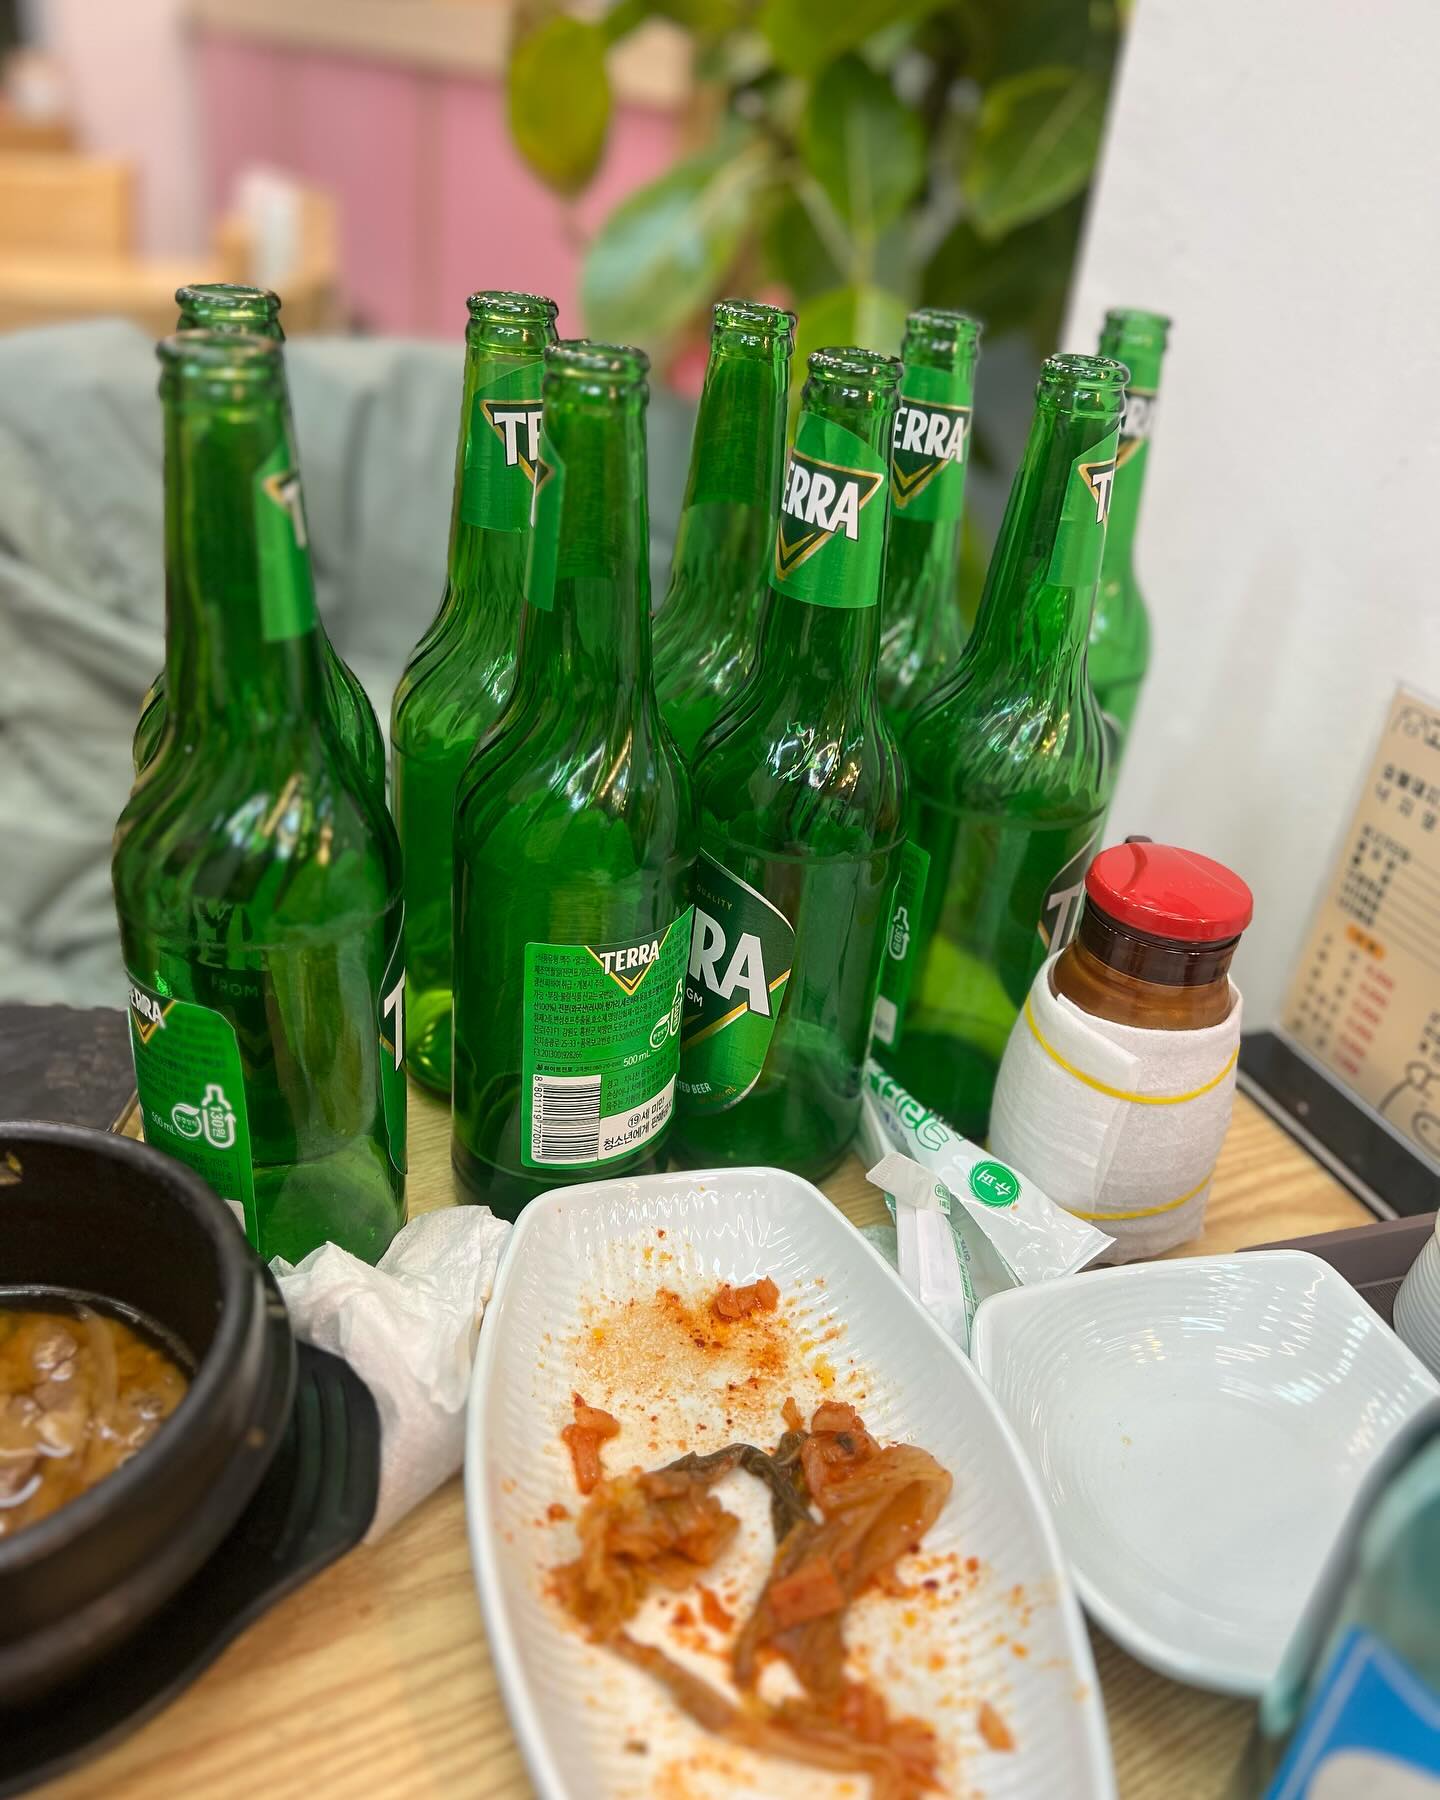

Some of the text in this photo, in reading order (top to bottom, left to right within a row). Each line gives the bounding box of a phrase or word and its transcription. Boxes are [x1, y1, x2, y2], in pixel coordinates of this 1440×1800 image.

[599, 939, 660, 975] TERRA
[623, 1055, 638, 1067] 500
[639, 1050, 651, 1061] mL
[692, 1082, 712, 1094] BEER
[603, 1122, 650, 1151] 청소년에게
[976, 1168, 1013, 1197] 슈퍼
